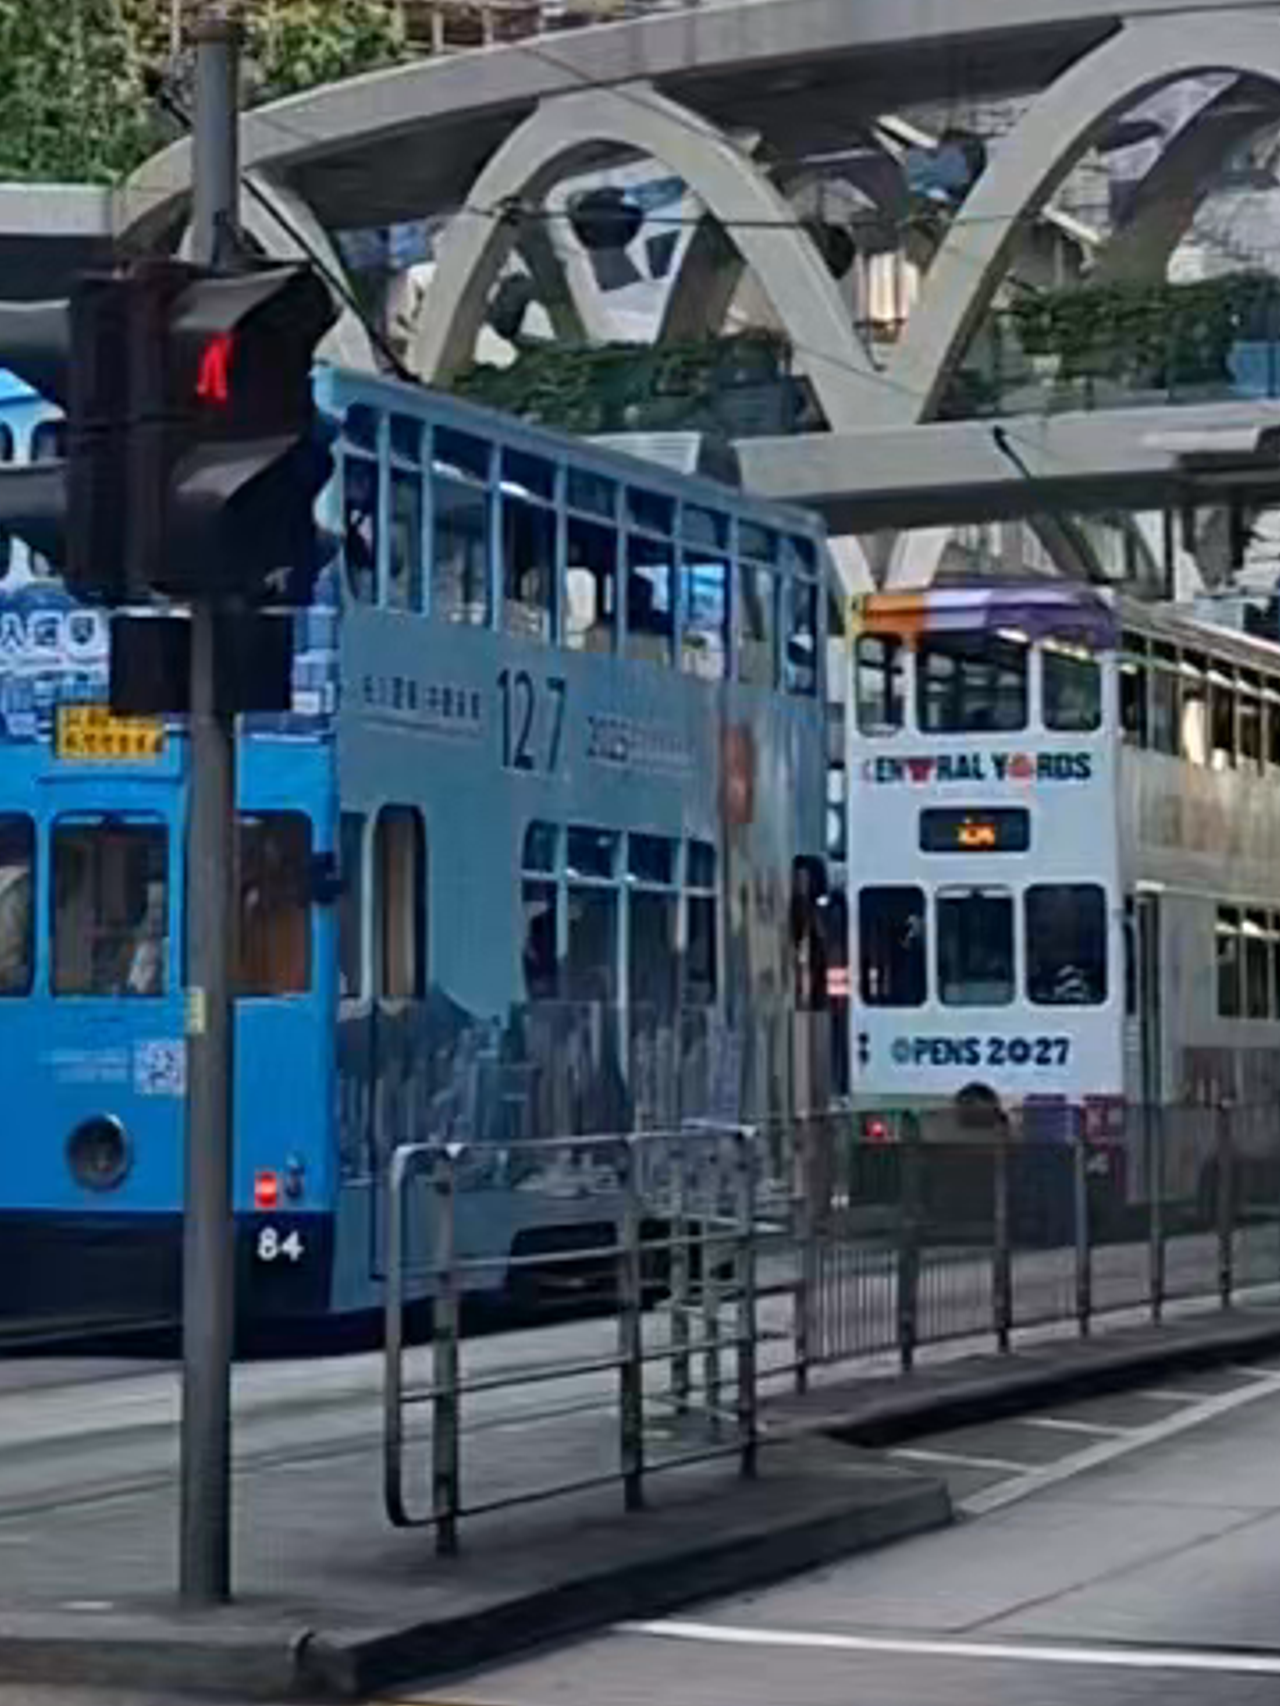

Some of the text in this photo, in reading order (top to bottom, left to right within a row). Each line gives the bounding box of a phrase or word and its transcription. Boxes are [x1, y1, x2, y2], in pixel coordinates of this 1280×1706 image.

[890, 1037, 1070, 1066] OPENS 2027
[256, 1228, 304, 1263] 84
